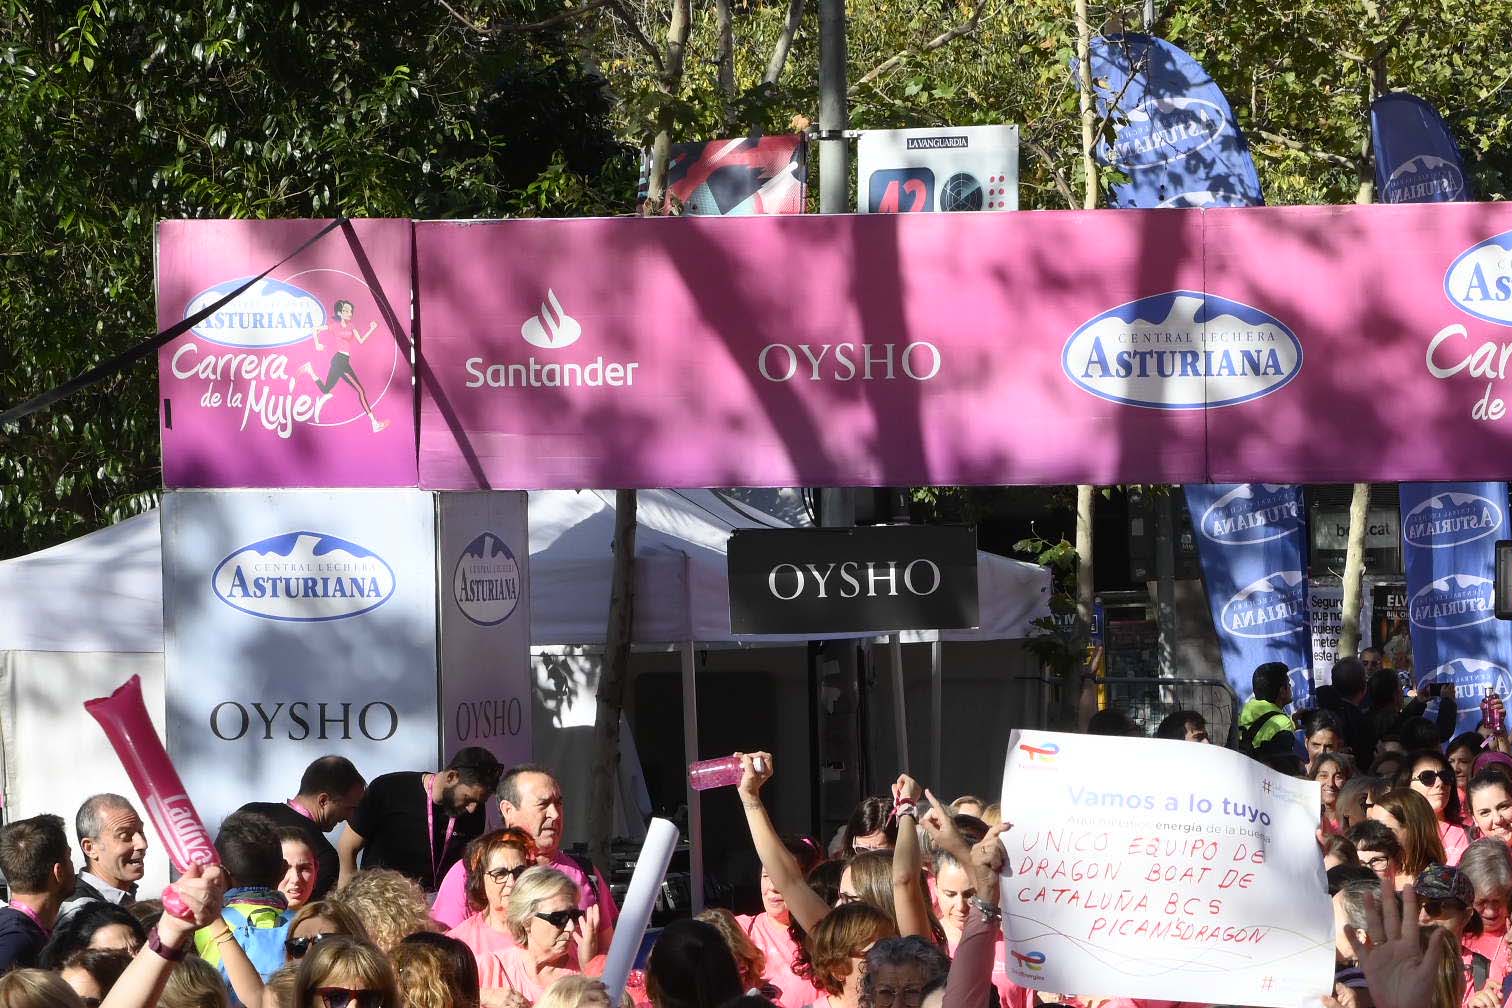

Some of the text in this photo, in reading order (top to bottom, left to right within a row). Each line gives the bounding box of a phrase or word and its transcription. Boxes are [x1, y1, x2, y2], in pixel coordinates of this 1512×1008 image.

[1118, 331, 1276, 344] CENTRAL LECHERA
[171, 342, 289, 380] Carrera
[464, 356, 639, 388] Santander
[758, 341, 942, 382] OYSHO
[1081, 336, 1285, 378] ASTURIANA
[200, 378, 333, 438] de la Mujer
[1472, 382, 1506, 421] de
[226, 565, 382, 599] ASTURIANA
[254, 562, 376, 573] CENTRAL LECHERA
[768, 559, 941, 600] OYSHO
[459, 576, 517, 603] ASTURIANA
[209, 701, 398, 741] OYSHO
[456, 698, 522, 741] OYSHO
[1067, 783, 1271, 826] Vamos a lo tuyo
[1155, 821, 1203, 834] energía
[1205, 824, 1222, 834] de
[1225, 824, 1236, 836] la
[1128, 836, 1219, 862] EQUIPO
[1232, 843, 1266, 866] DE
[1018, 856, 1257, 890] DRAGON BOAT DE
[1017, 886, 1151, 912] CATALUÑA
